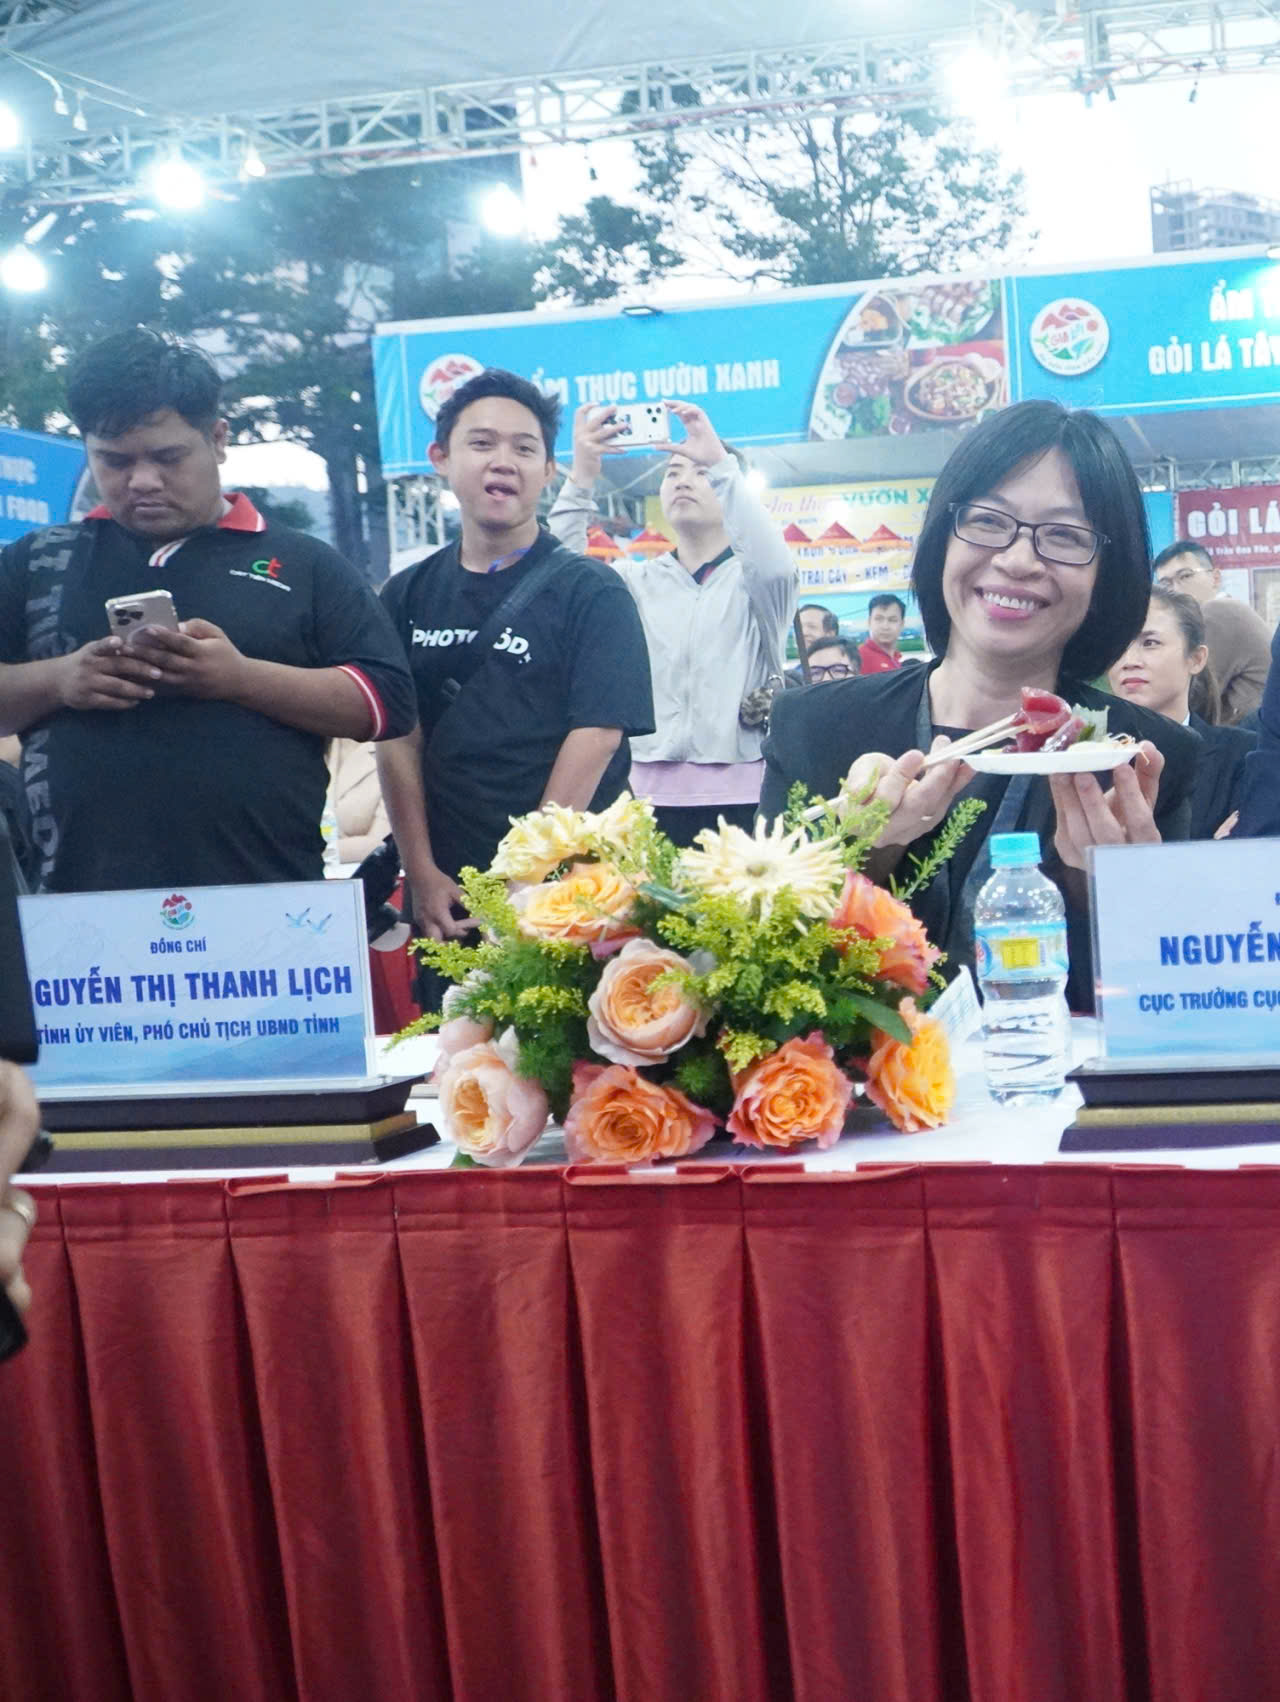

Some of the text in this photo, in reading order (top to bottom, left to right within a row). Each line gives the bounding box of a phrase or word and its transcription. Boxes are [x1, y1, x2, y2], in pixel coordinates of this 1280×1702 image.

[643, 361, 708, 396] VƯỜN
[715, 359, 780, 392] XANH
[186, 936, 207, 953] CHÍ
[35, 966, 353, 1007] GUYỄN THỊ THANH LỊCH
[1139, 993, 1175, 1015] CỤC
[1180, 986, 1248, 1010] TRƯỞNG
[75, 1020, 97, 1043] ỦY
[99, 1019, 139, 1044] VIÊN,
[143, 1018, 173, 1041] PHÓ
[178, 1015, 210, 1038] CHỦ
[214, 1016, 252, 1042] TỊCH
[256, 1017, 298, 1035] UBND
[303, 1012, 340, 1034] TỈNH
